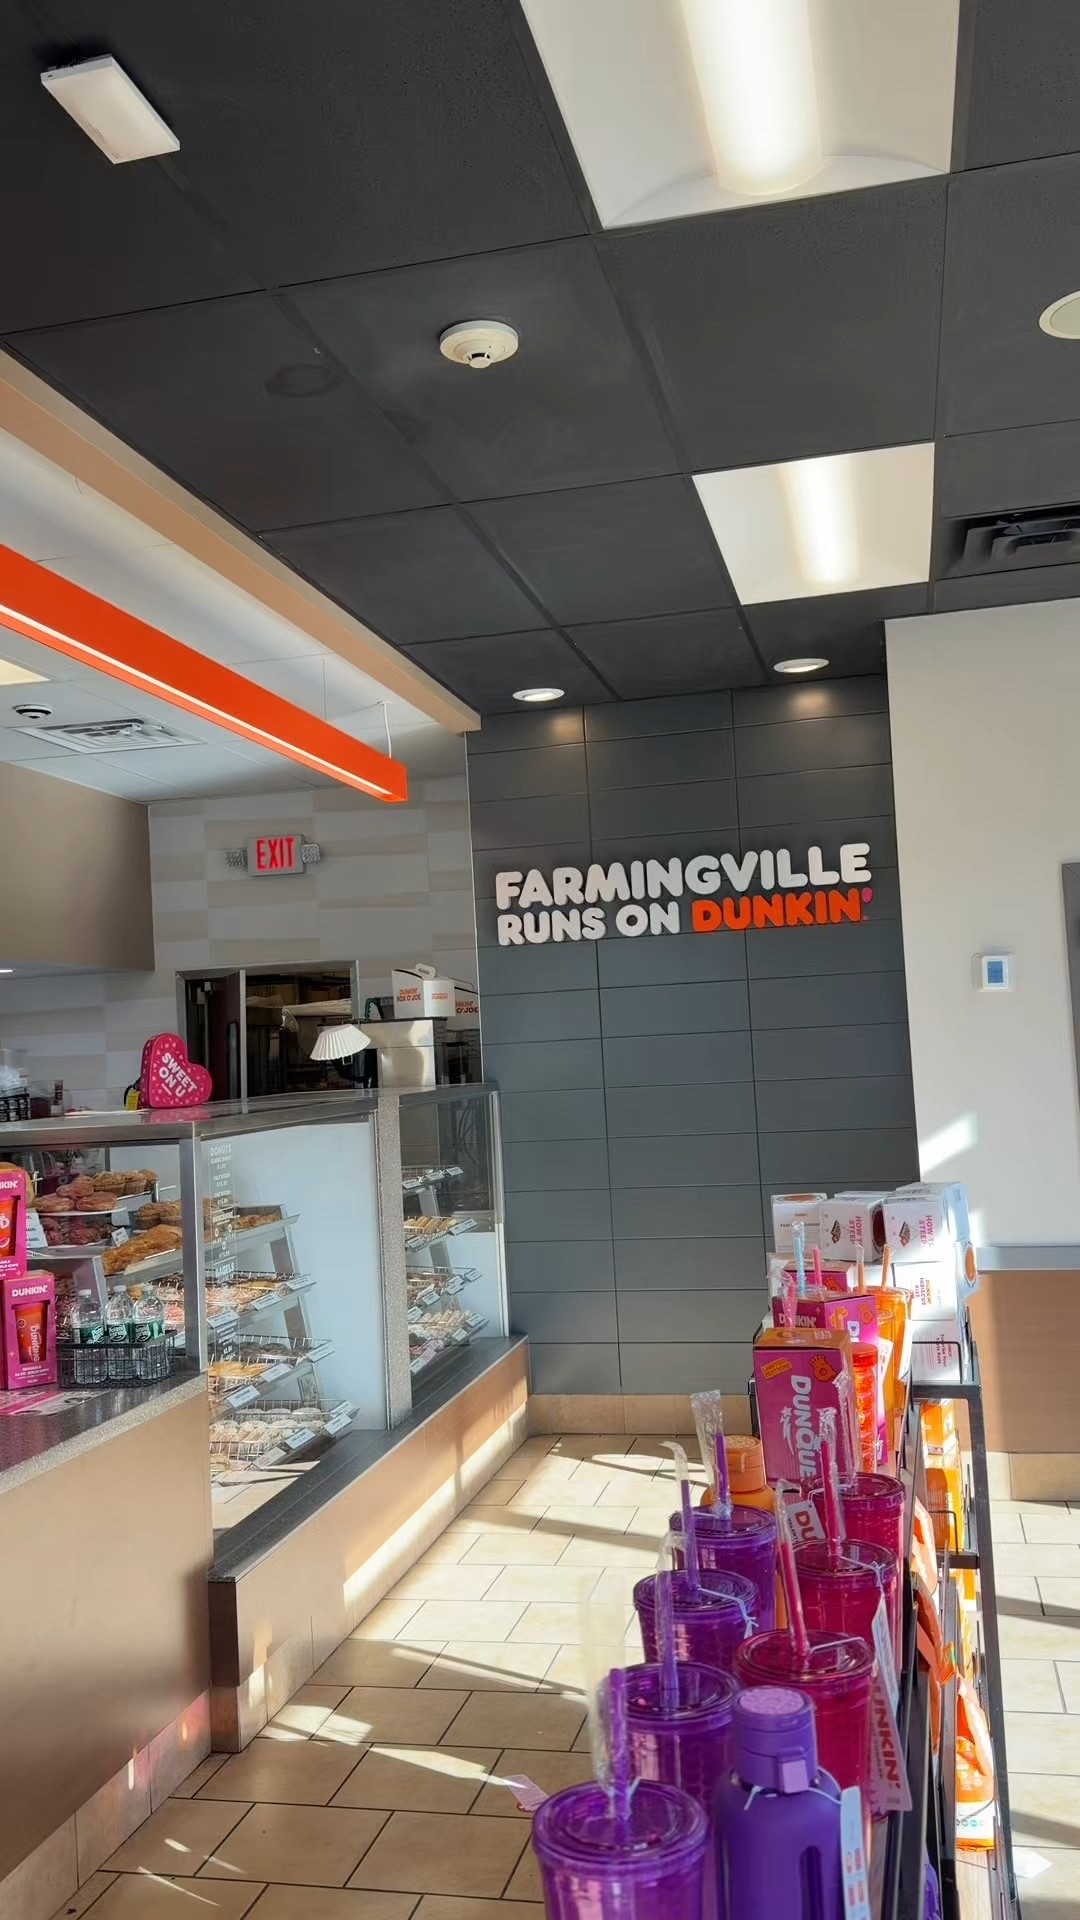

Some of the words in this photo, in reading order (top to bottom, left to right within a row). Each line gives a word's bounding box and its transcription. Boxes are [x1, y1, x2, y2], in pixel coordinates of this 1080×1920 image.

[256, 836, 295, 871] EXIT
[495, 843, 872, 910] FARMINGVILLE
[497, 907, 607, 946] RUNS
[615, 901, 681, 938] ON
[691, 887, 873, 933] DUNKIN'
[159, 1066, 177, 1088] ON
[175, 1085, 186, 1097] U
[161, 1052, 197, 1093] SWEET
[919, 1219, 927, 1245] STEEP
[925, 1215, 933, 1236] HOW
[11, 1284, 48, 1298] DUNKIN'
[778, 1312, 817, 1328] DKIN'
